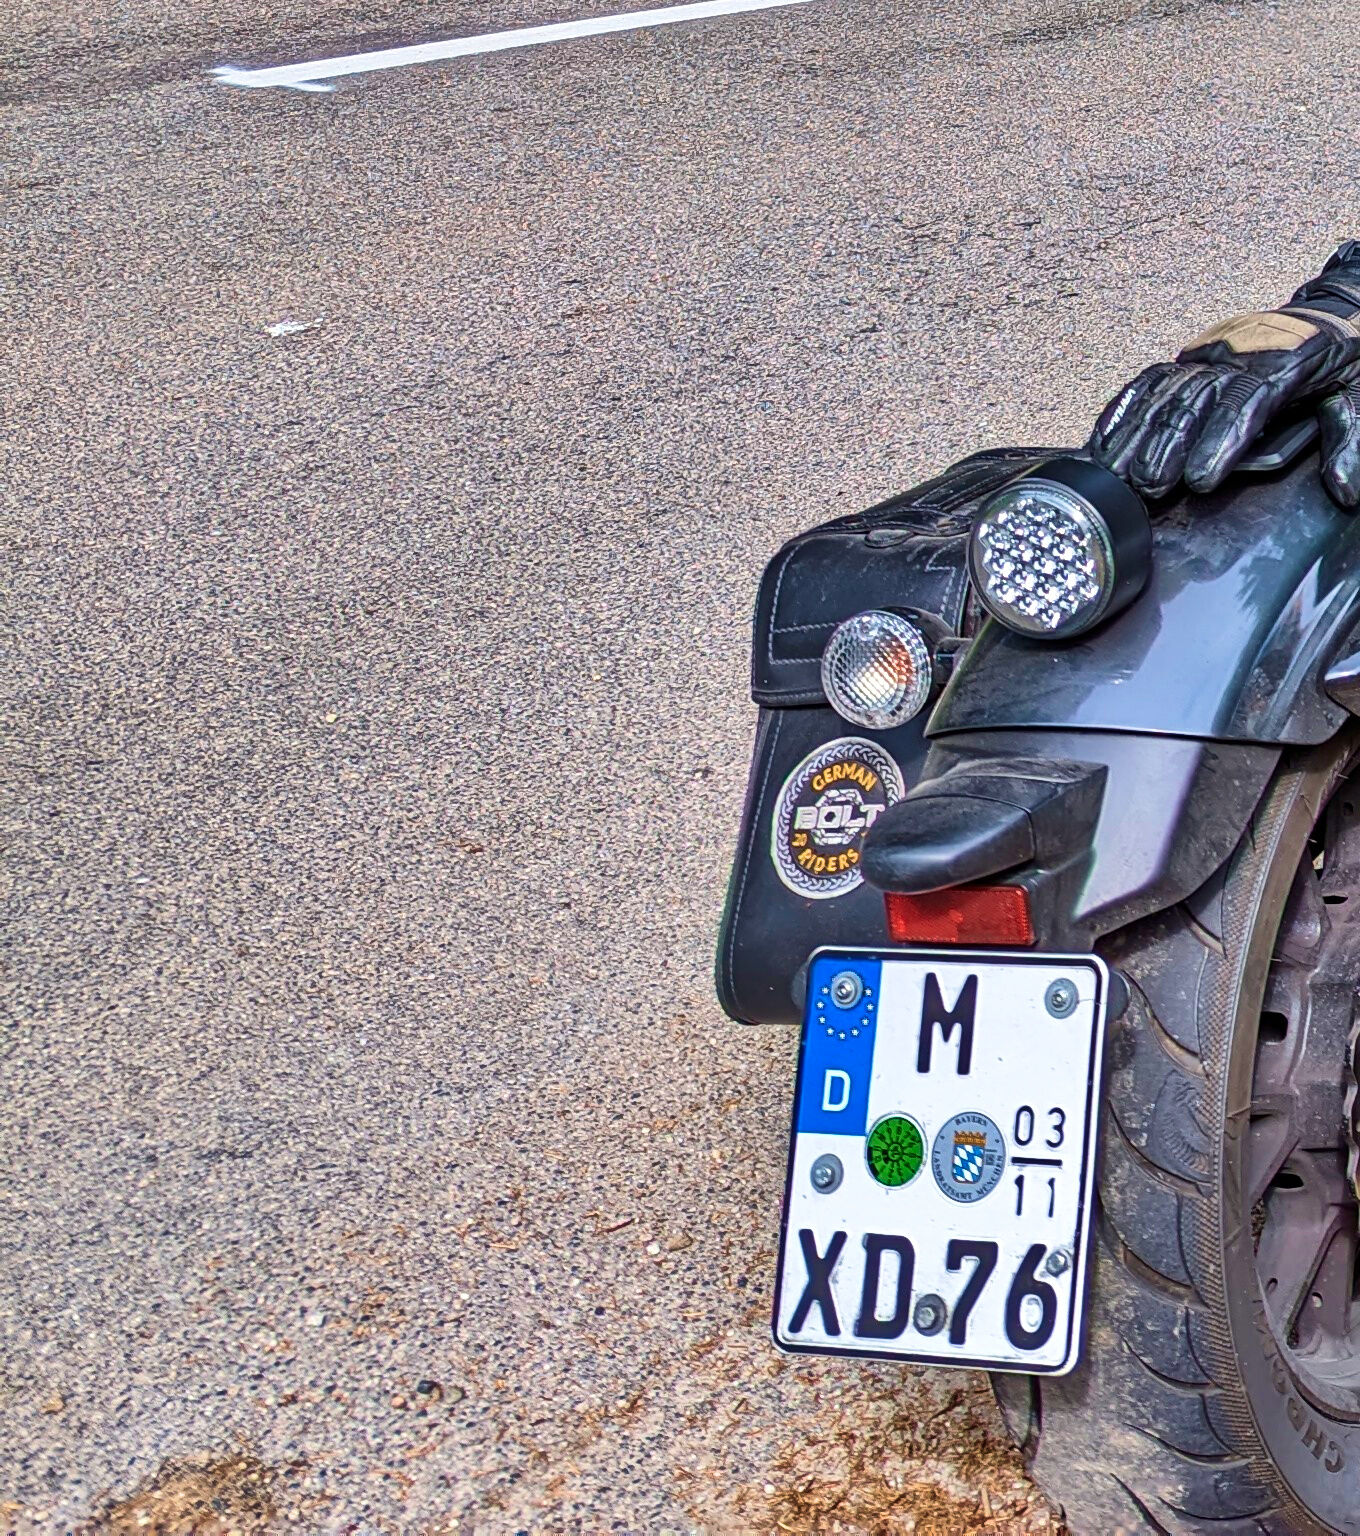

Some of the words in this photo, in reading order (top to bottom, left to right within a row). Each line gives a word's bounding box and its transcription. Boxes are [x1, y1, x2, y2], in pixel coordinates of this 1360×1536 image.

[812, 763, 878, 792] GERMAN
[794, 804, 886, 830] BOLT
[798, 848, 860, 873] RIDERS
[916, 972, 979, 1076] M
[821, 1069, 851, 1112] D
[1013, 1105, 1067, 1149] 03
[1013, 1175, 1057, 1218] 11
[787, 1228, 916, 1339] XD
[945, 1239, 1059, 1351] 76
